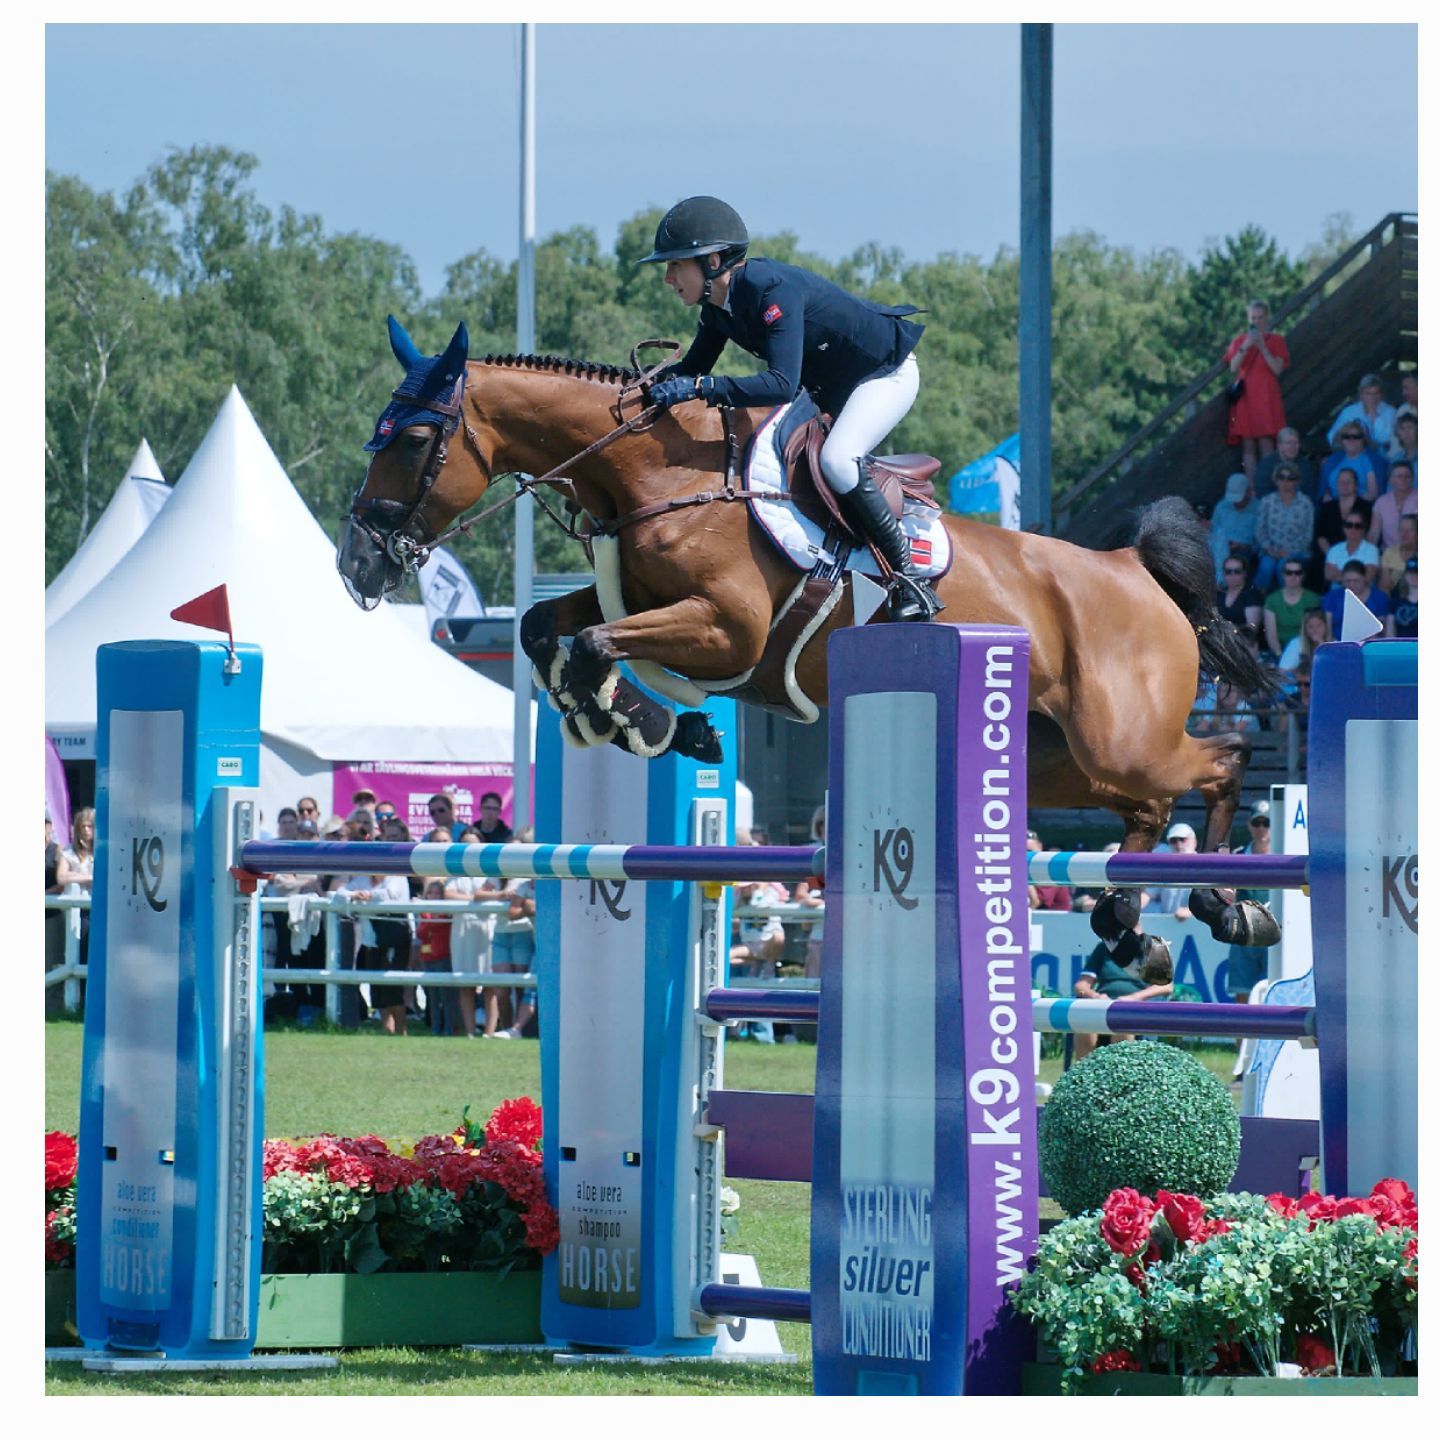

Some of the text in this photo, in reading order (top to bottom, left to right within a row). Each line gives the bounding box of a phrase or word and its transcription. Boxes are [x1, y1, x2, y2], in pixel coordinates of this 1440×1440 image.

[132, 836, 167, 912] K9
[874, 827, 919, 911] K9
[971, 646, 1021, 1286] www.k9competition.com
[577, 1180, 622, 1202] aloe vera
[843, 1184, 931, 1246] STERLING
[580, 1216, 621, 1240] shampoo
[104, 1243, 166, 1295] HORSE
[562, 1244, 635, 1293] HORSE
[844, 1246, 930, 1296] silver
[842, 1300, 930, 1361] CONDITIONER
